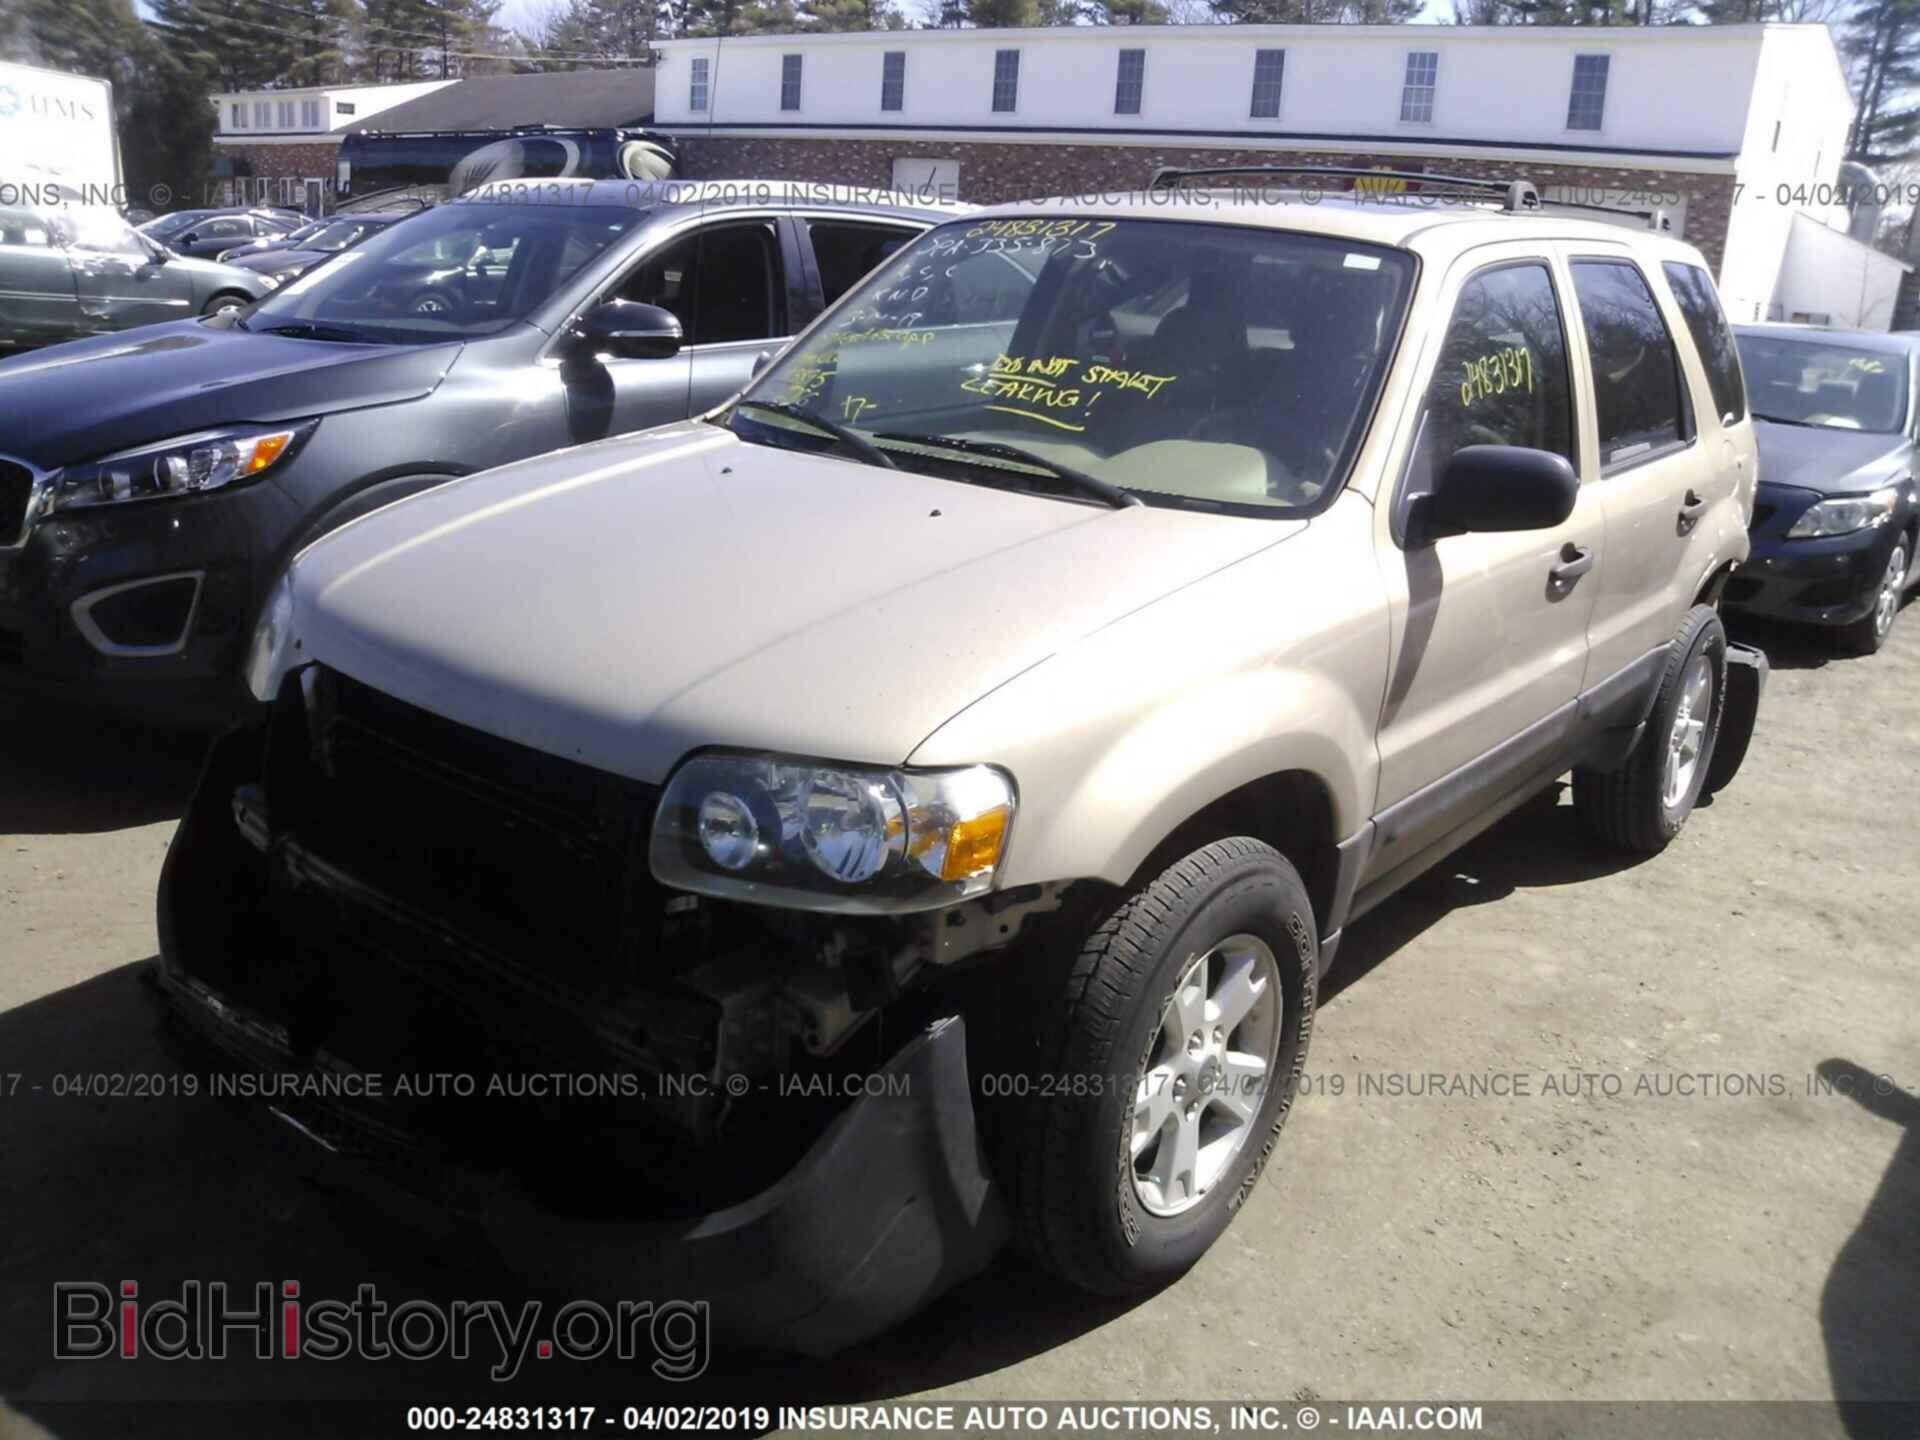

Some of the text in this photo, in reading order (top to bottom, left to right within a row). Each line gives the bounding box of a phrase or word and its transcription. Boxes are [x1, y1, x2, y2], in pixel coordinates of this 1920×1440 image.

[965, 219, 1116, 241] 24831317
[991, 353, 1025, 374] DO
[1027, 355, 1080, 376] NOT
[1461, 347, 1533, 407] 24831317
